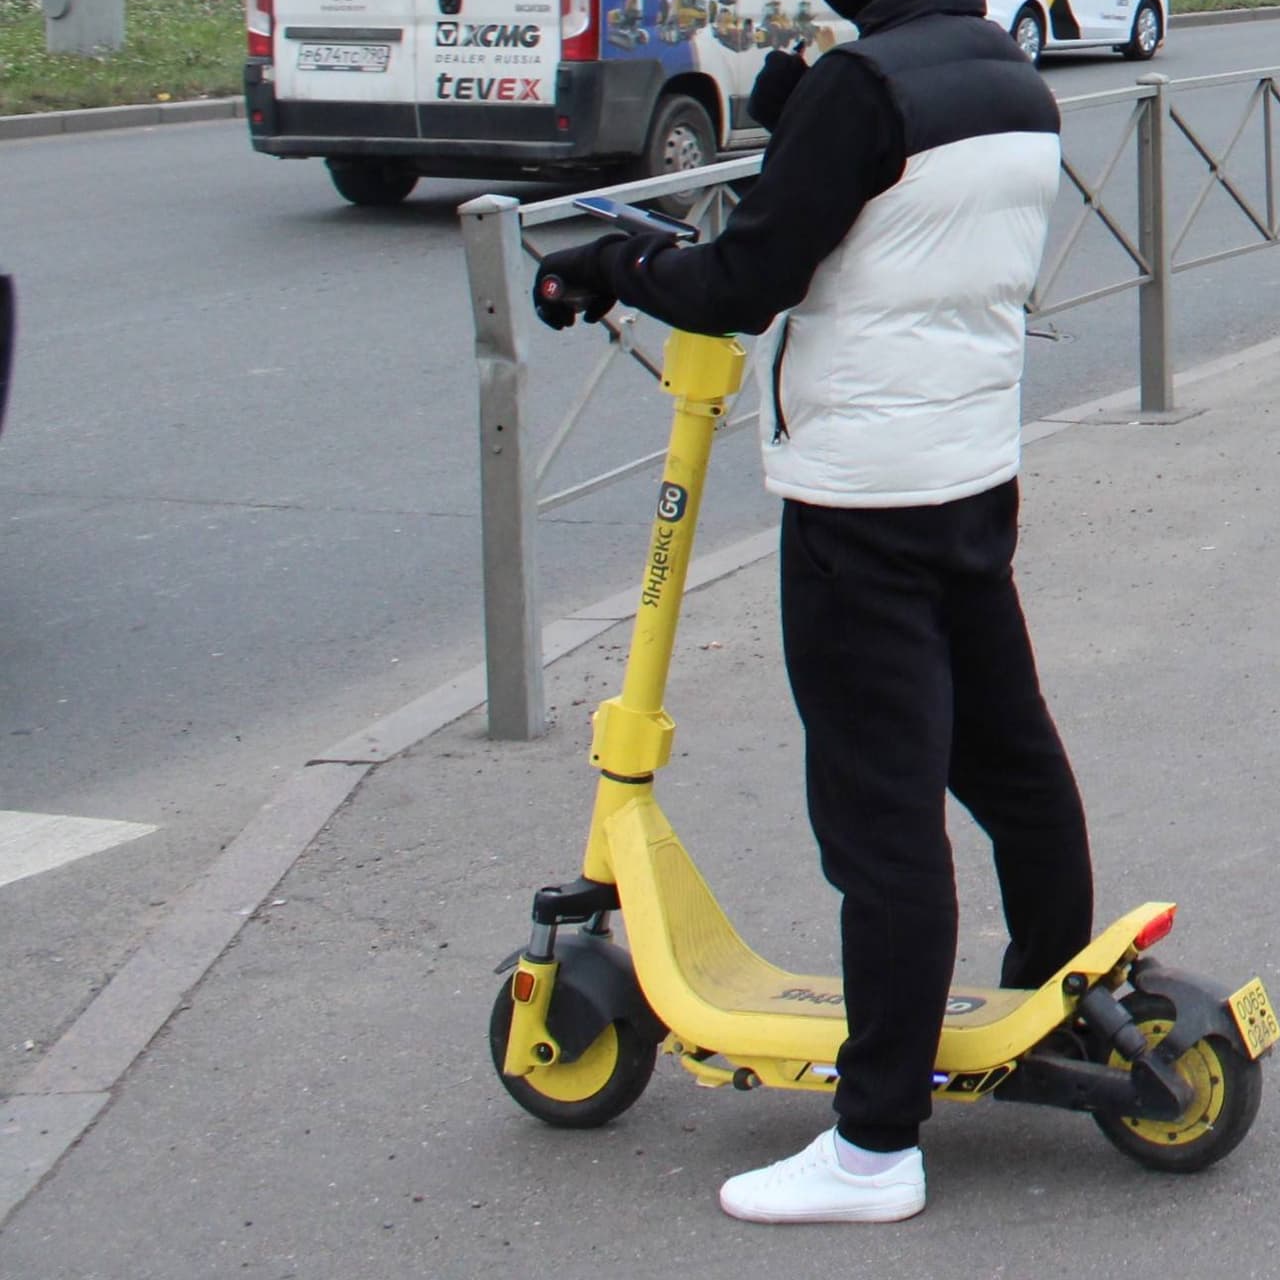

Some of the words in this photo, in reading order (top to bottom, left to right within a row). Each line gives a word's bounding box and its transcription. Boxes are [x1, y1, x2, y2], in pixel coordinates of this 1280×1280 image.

[464, 24, 541, 48] XCMG
[435, 54, 485, 64] DEALER
[495, 54, 541, 64] RUSSIA
[641, 526, 673, 608] Яндекс
[658, 486, 682, 519] Go
